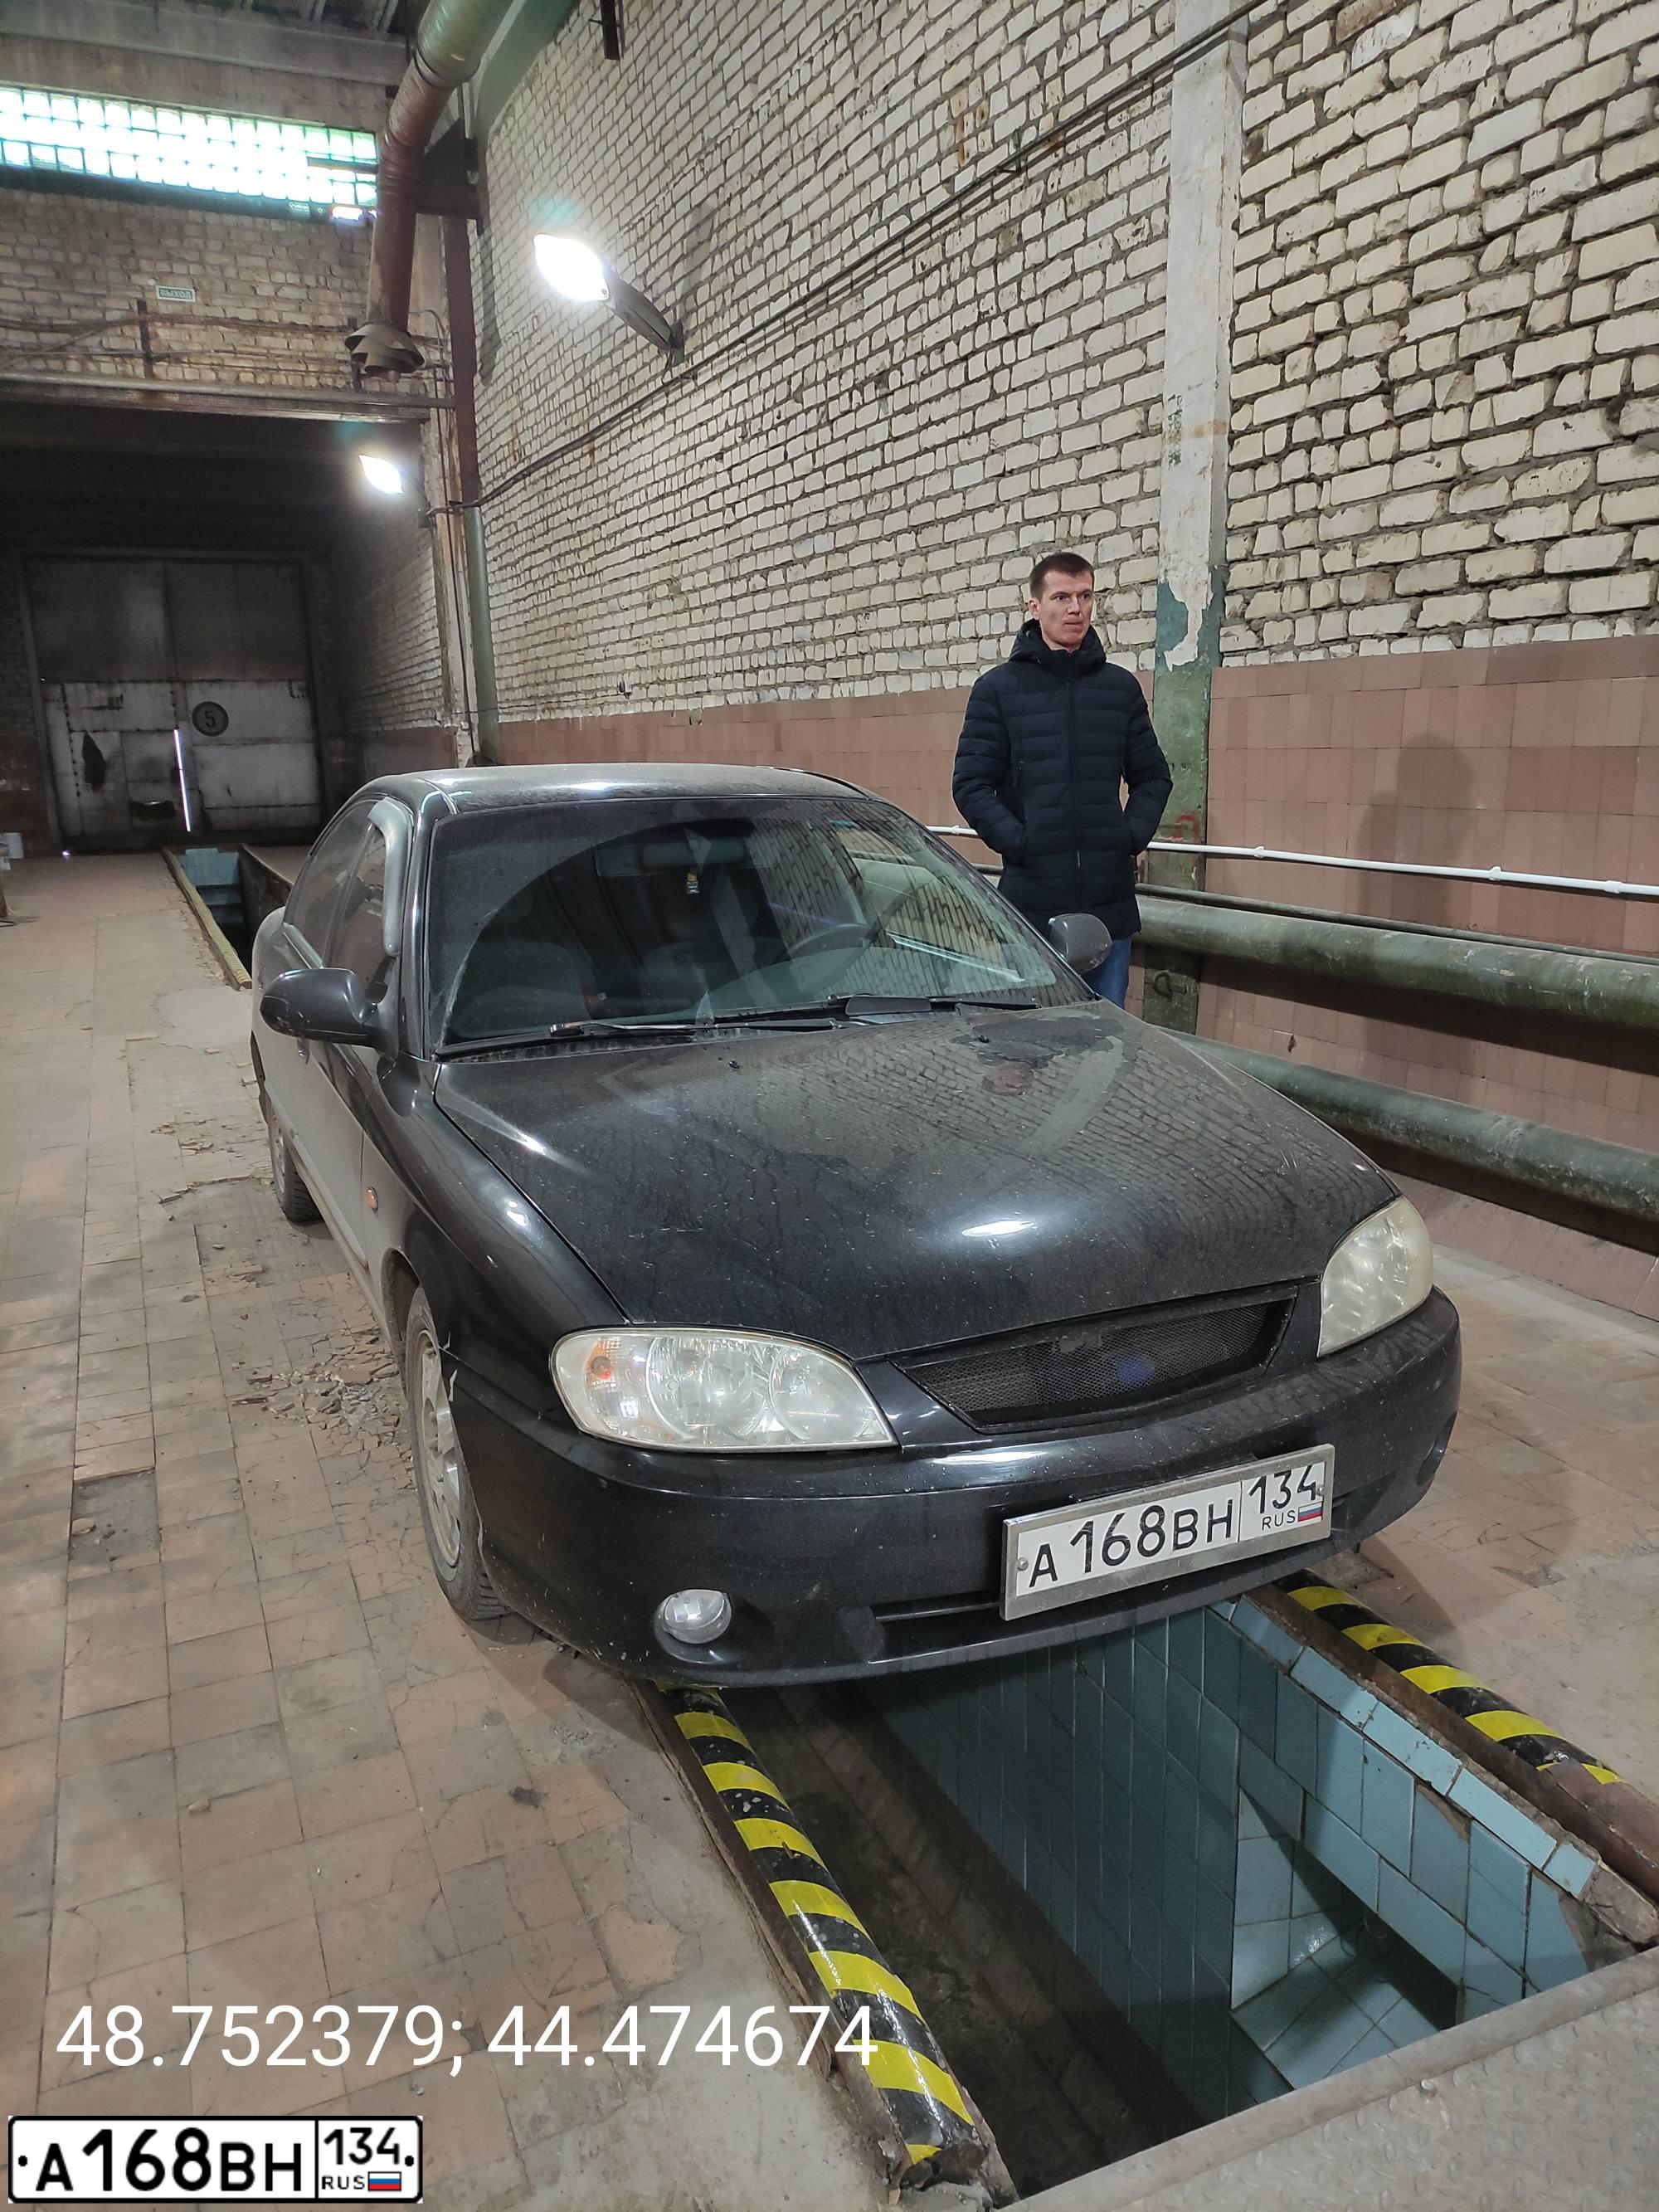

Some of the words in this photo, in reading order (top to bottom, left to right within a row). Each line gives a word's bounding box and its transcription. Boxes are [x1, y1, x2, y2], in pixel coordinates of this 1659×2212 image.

[205, 710, 216, 728] 5
[1248, 1464, 1317, 1515] 134
[1261, 1508, 1297, 1532] RUS
